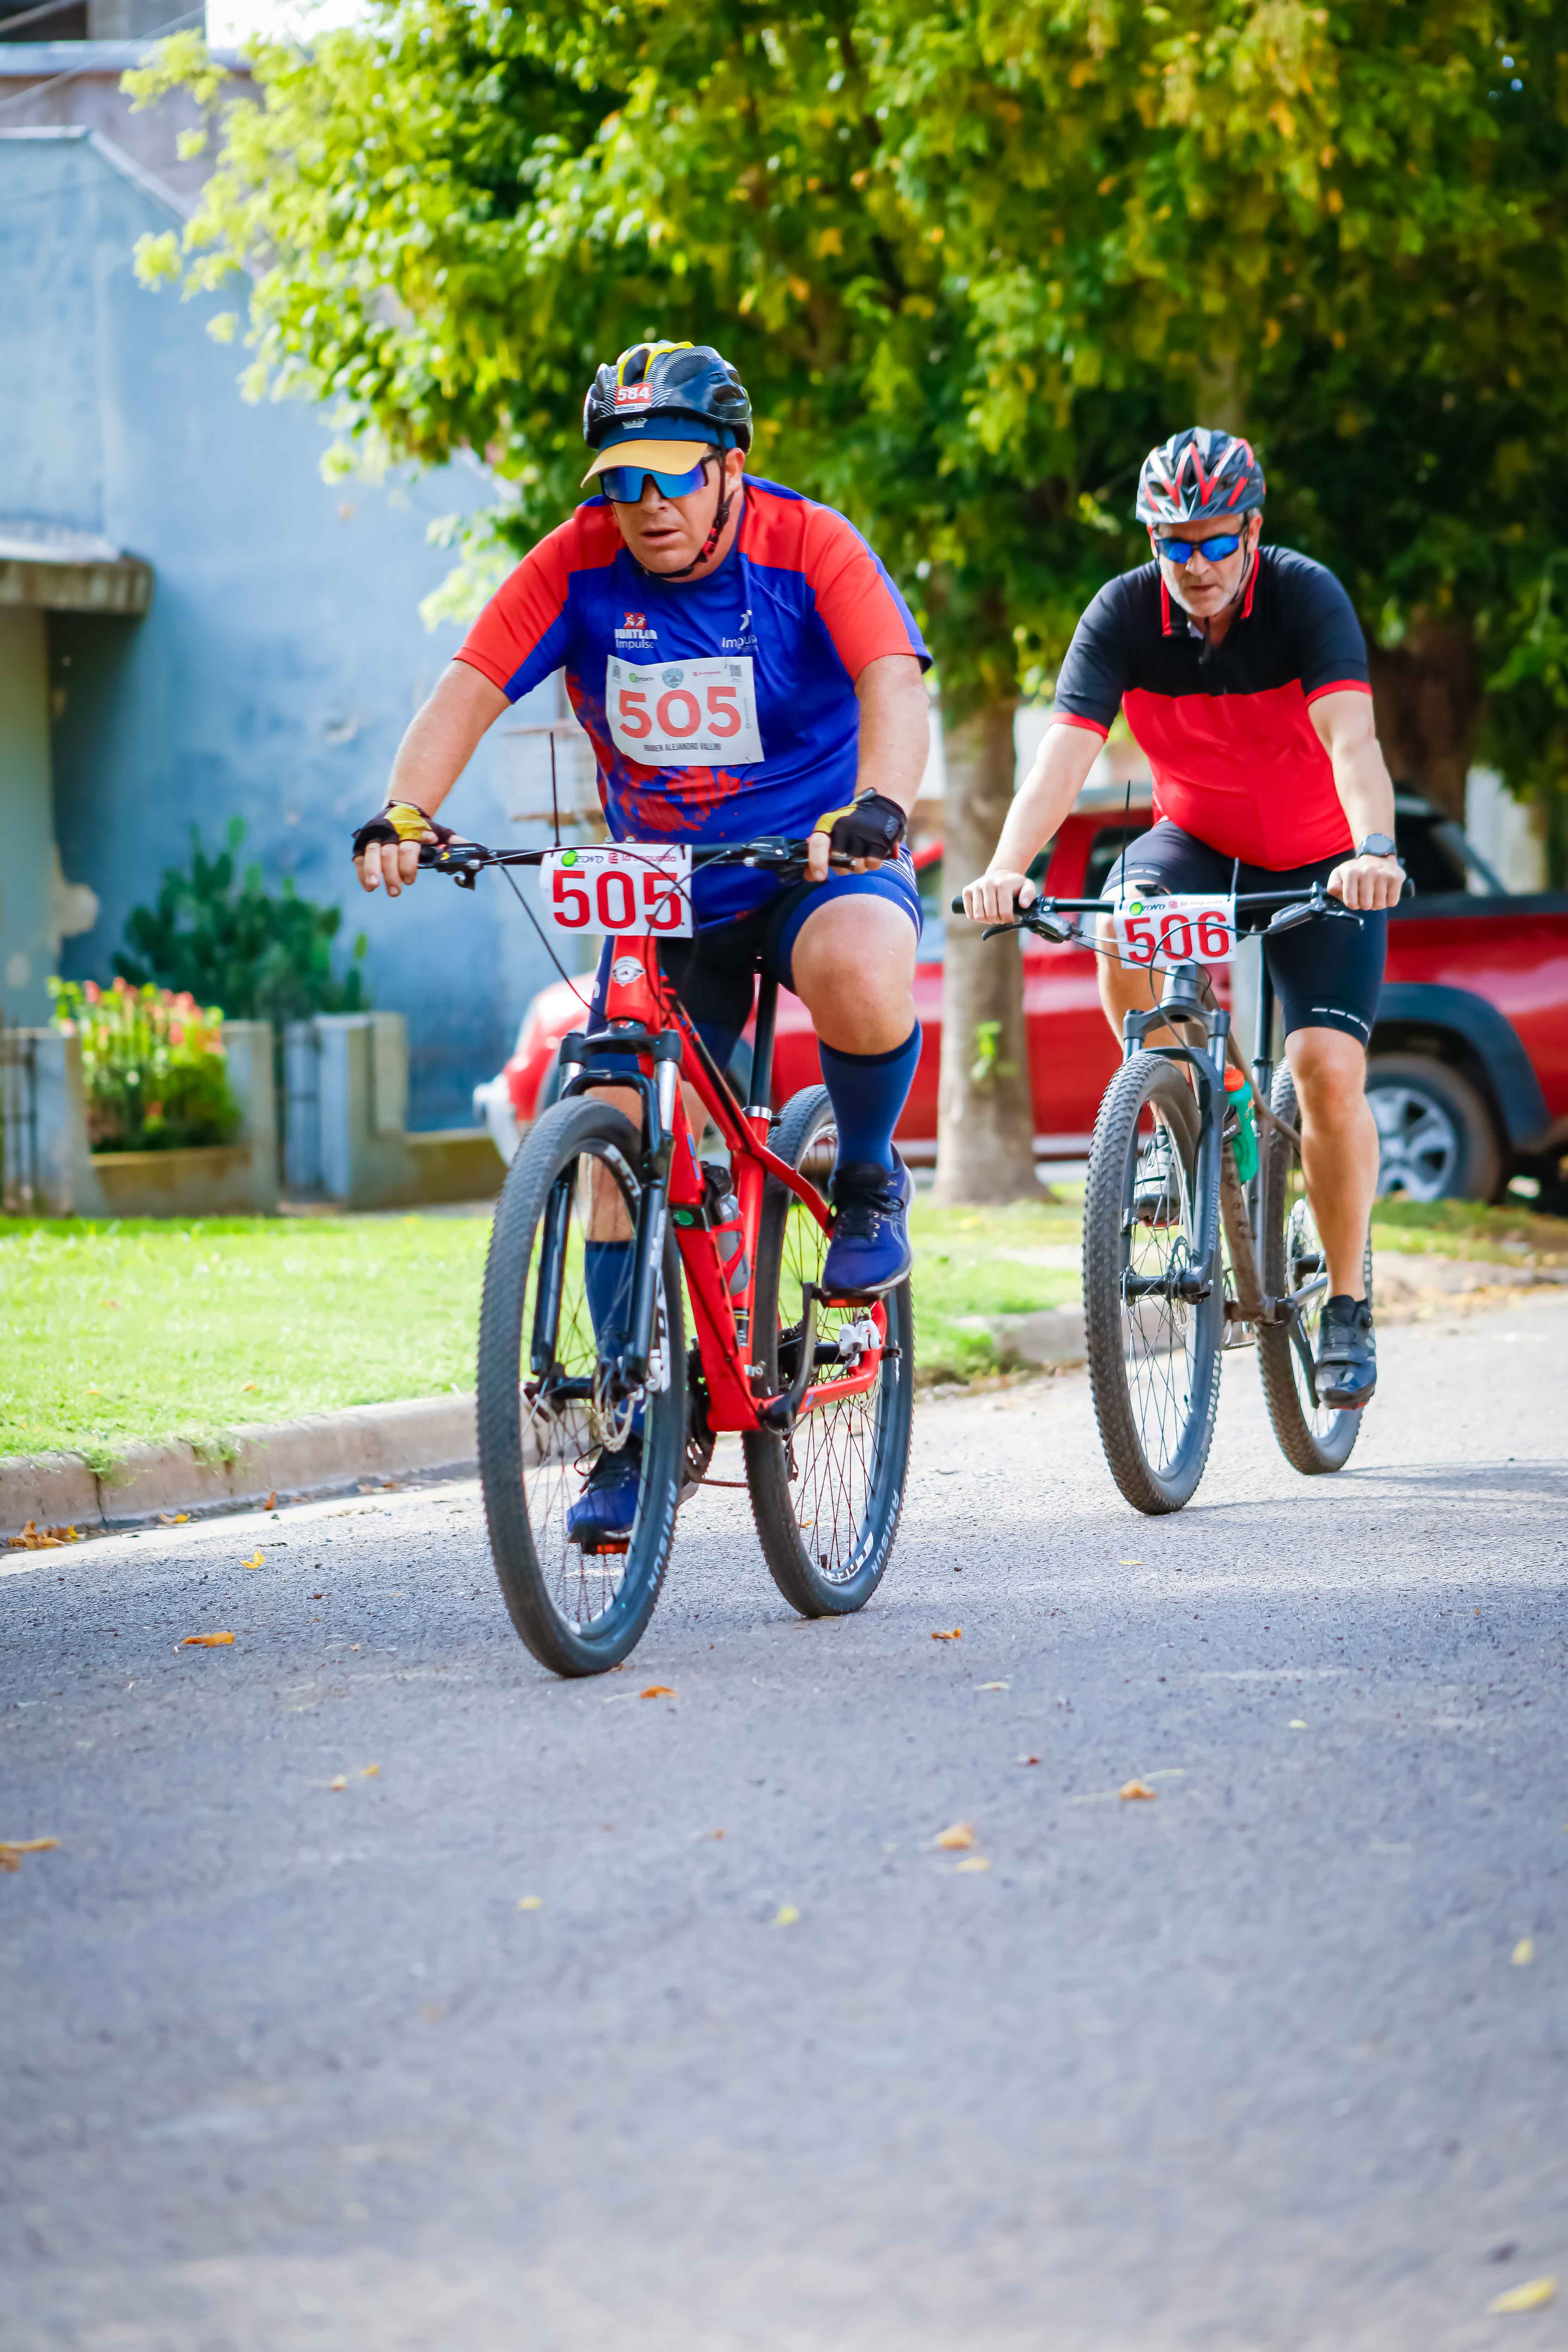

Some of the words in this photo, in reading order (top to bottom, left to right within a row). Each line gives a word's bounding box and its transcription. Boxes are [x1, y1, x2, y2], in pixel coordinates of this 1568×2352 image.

[617, 387, 650, 401] 584
[618, 686, 741, 739] 505
[553, 870, 682, 930] 505
[1124, 911, 1229, 963] 506
[871, 1488, 899, 1576] ARISUN
